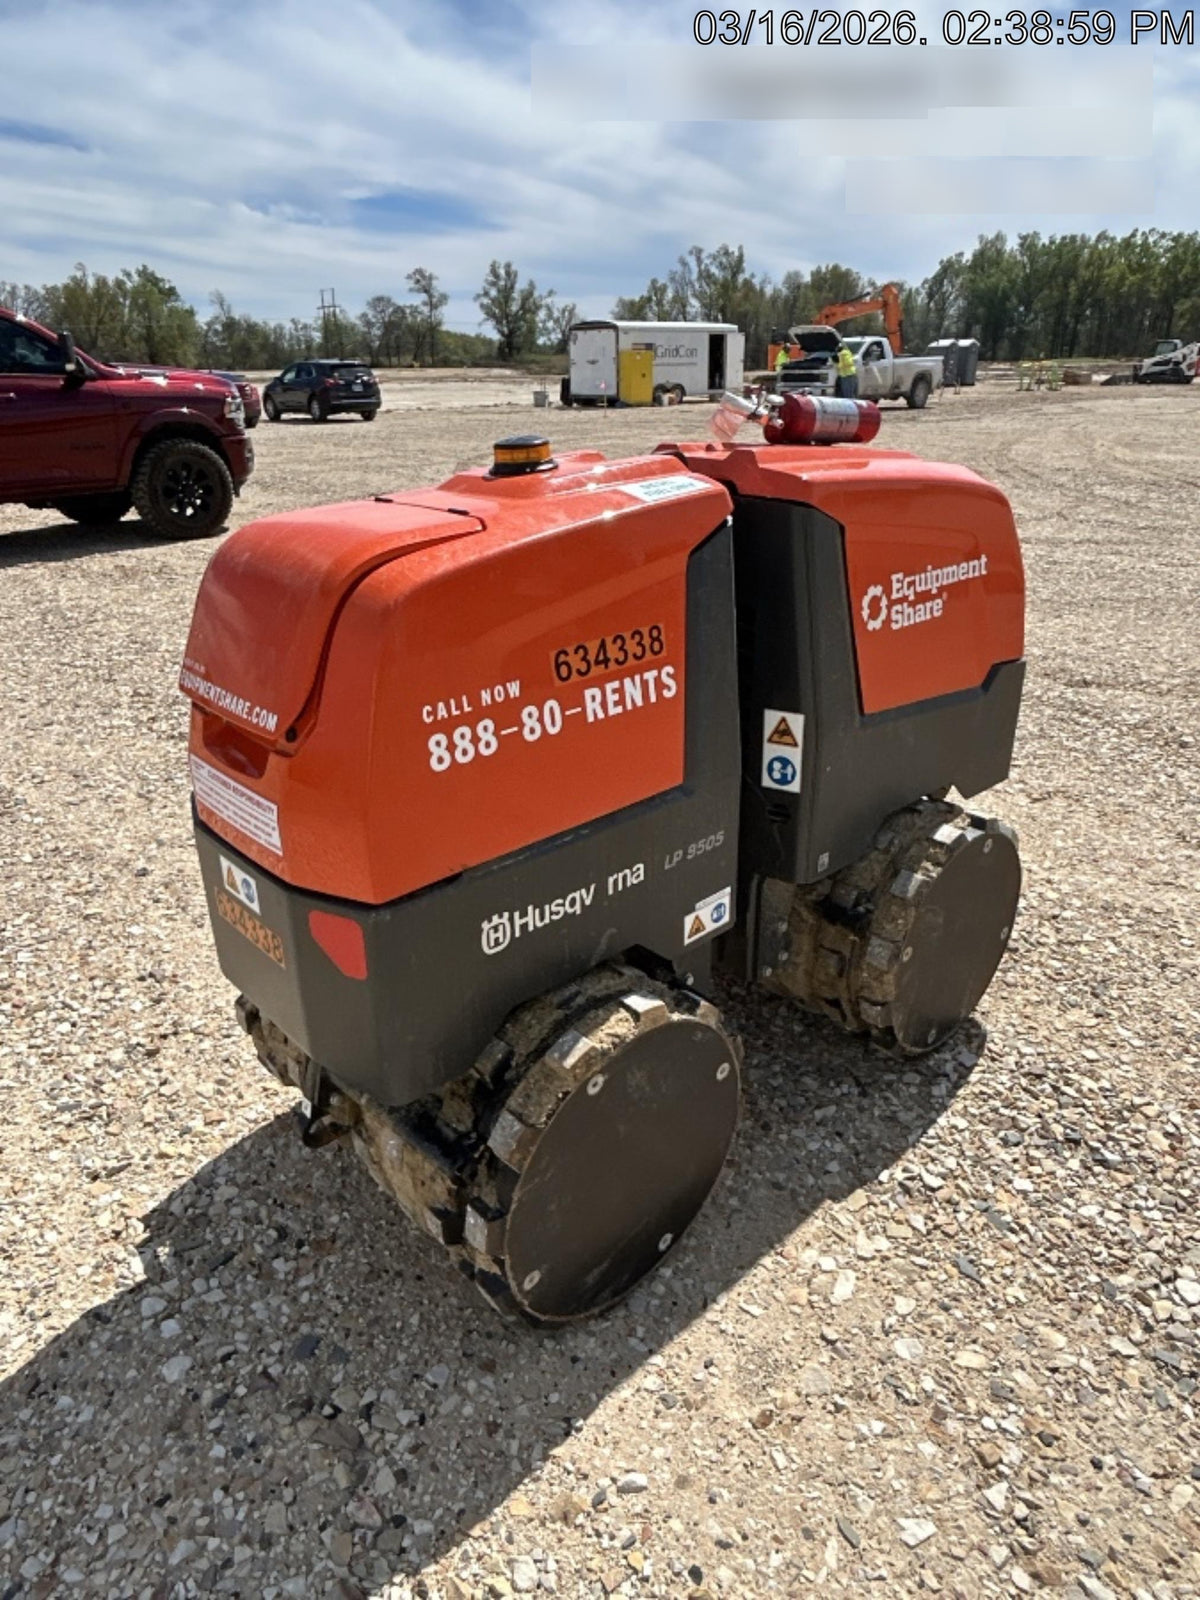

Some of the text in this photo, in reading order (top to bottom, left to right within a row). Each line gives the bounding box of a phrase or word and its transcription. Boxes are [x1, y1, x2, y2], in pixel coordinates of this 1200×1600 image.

[890, 554, 987, 600] Equipment
[890, 597, 944, 630] Share
[554, 625, 664, 682] 634338
[422, 680, 520, 723] CALL NOW
[427, 665, 678, 772] 888-80-RENTS
[665, 849, 683, 870] LP
[513, 863, 645, 938] Husqvrna
